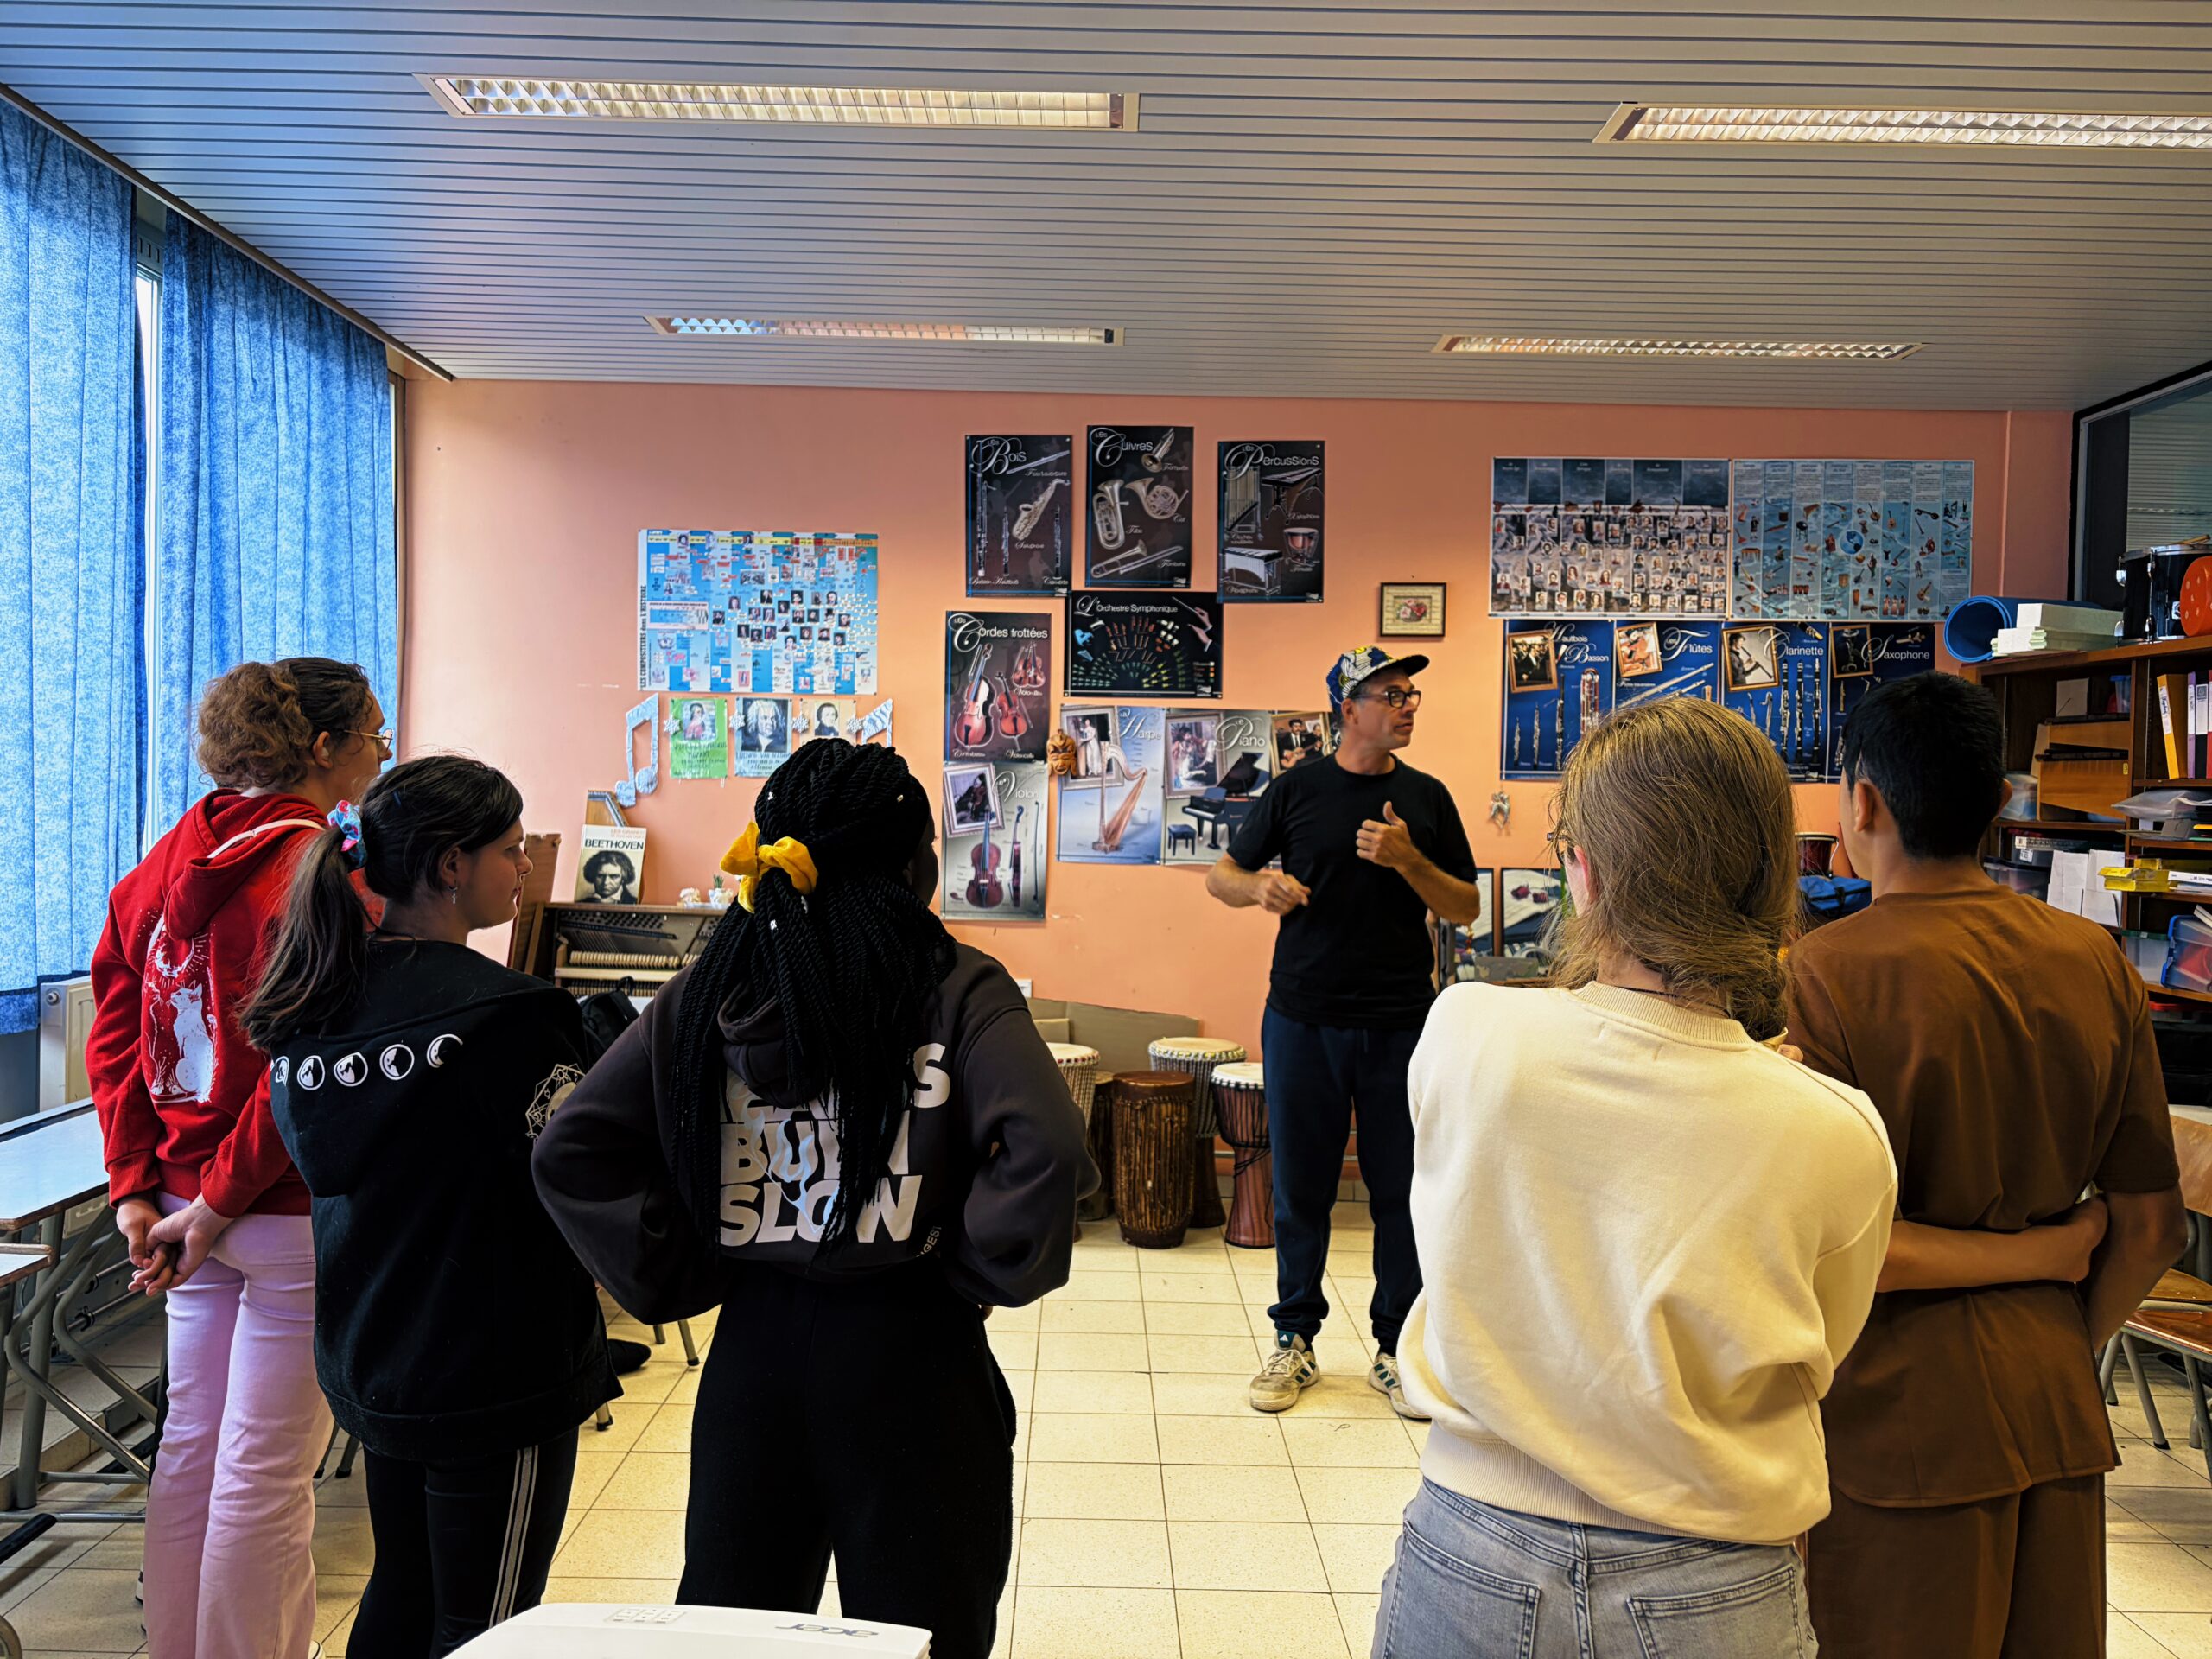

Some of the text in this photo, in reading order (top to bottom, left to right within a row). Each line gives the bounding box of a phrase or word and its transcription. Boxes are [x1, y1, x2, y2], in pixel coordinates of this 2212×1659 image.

[969, 436, 1027, 474] Bois
[1130, 604, 1178, 613] Symphonique
[948, 613, 1048, 652] Cordes frottées
[1544, 621, 1588, 643] Hautbois
[1758, 626, 1824, 661] Clarinette
[1564, 642, 1610, 664] Basson
[1861, 634, 1930, 668] Saxophone
[1215, 715, 1265, 750] Piano
[584, 838, 644, 850] BEETHOVEN
[721, 1175, 923, 1247] SLOW
[774, 1624, 880, 1638] acer
